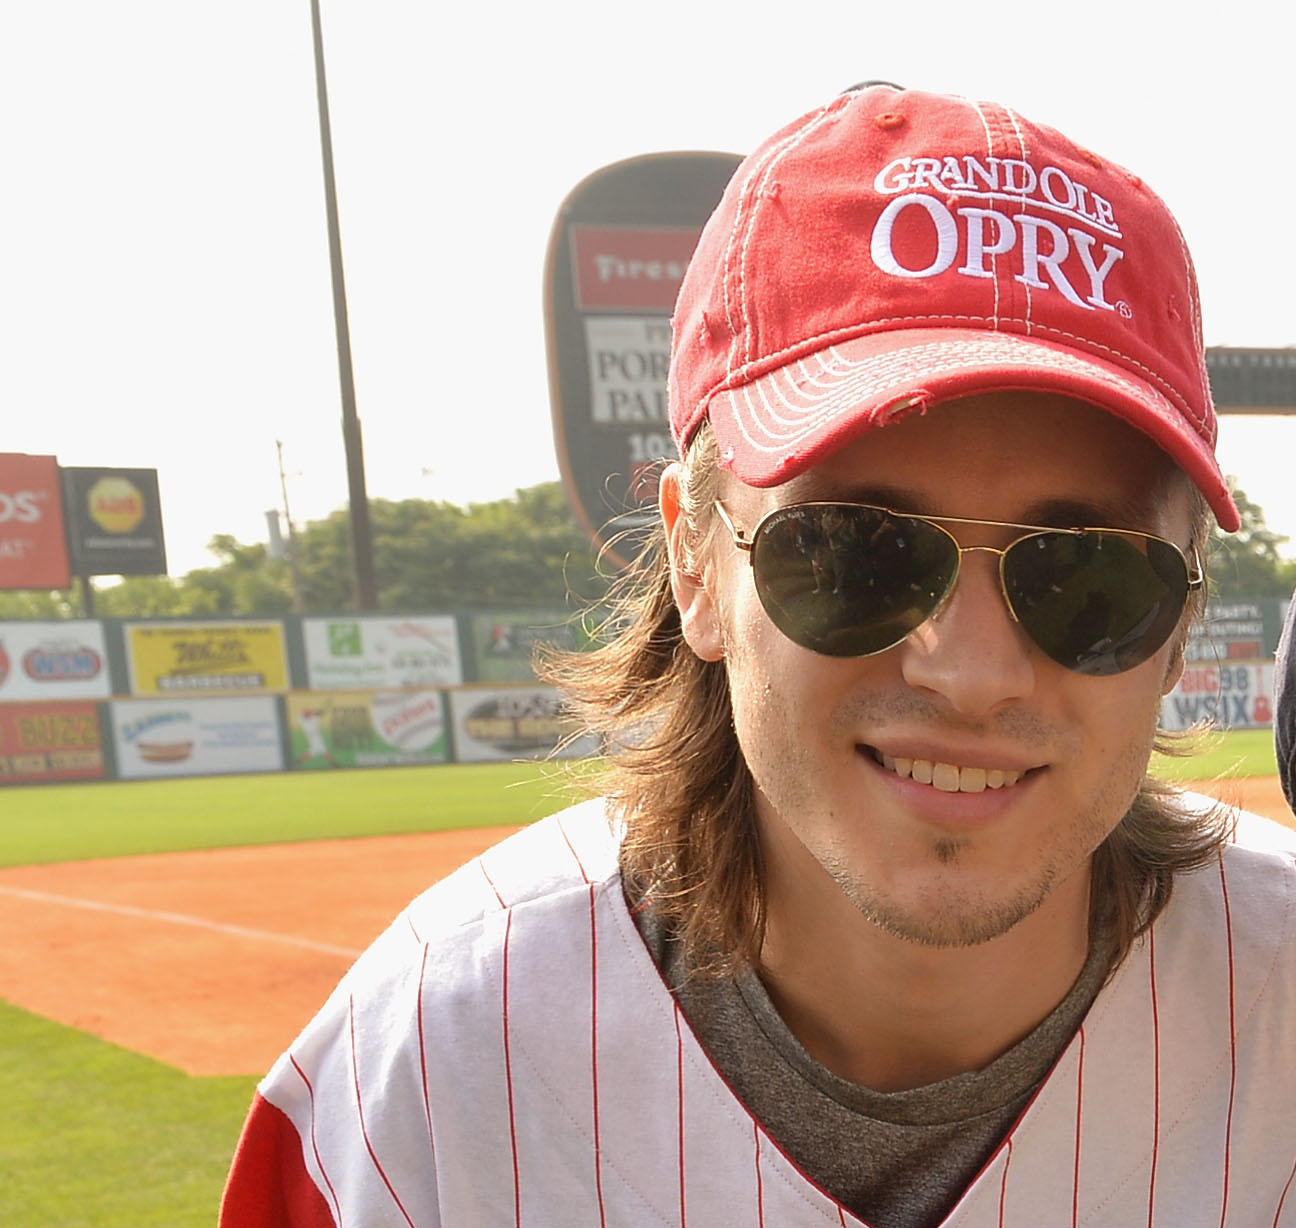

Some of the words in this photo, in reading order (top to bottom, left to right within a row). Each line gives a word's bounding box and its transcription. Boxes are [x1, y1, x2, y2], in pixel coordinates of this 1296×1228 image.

[874, 155, 1037, 194] GRAND
[1039, 166, 1119, 231] OLE
[871, 192, 1124, 311] OPRY
[1174, 695, 1249, 725] WSIX
